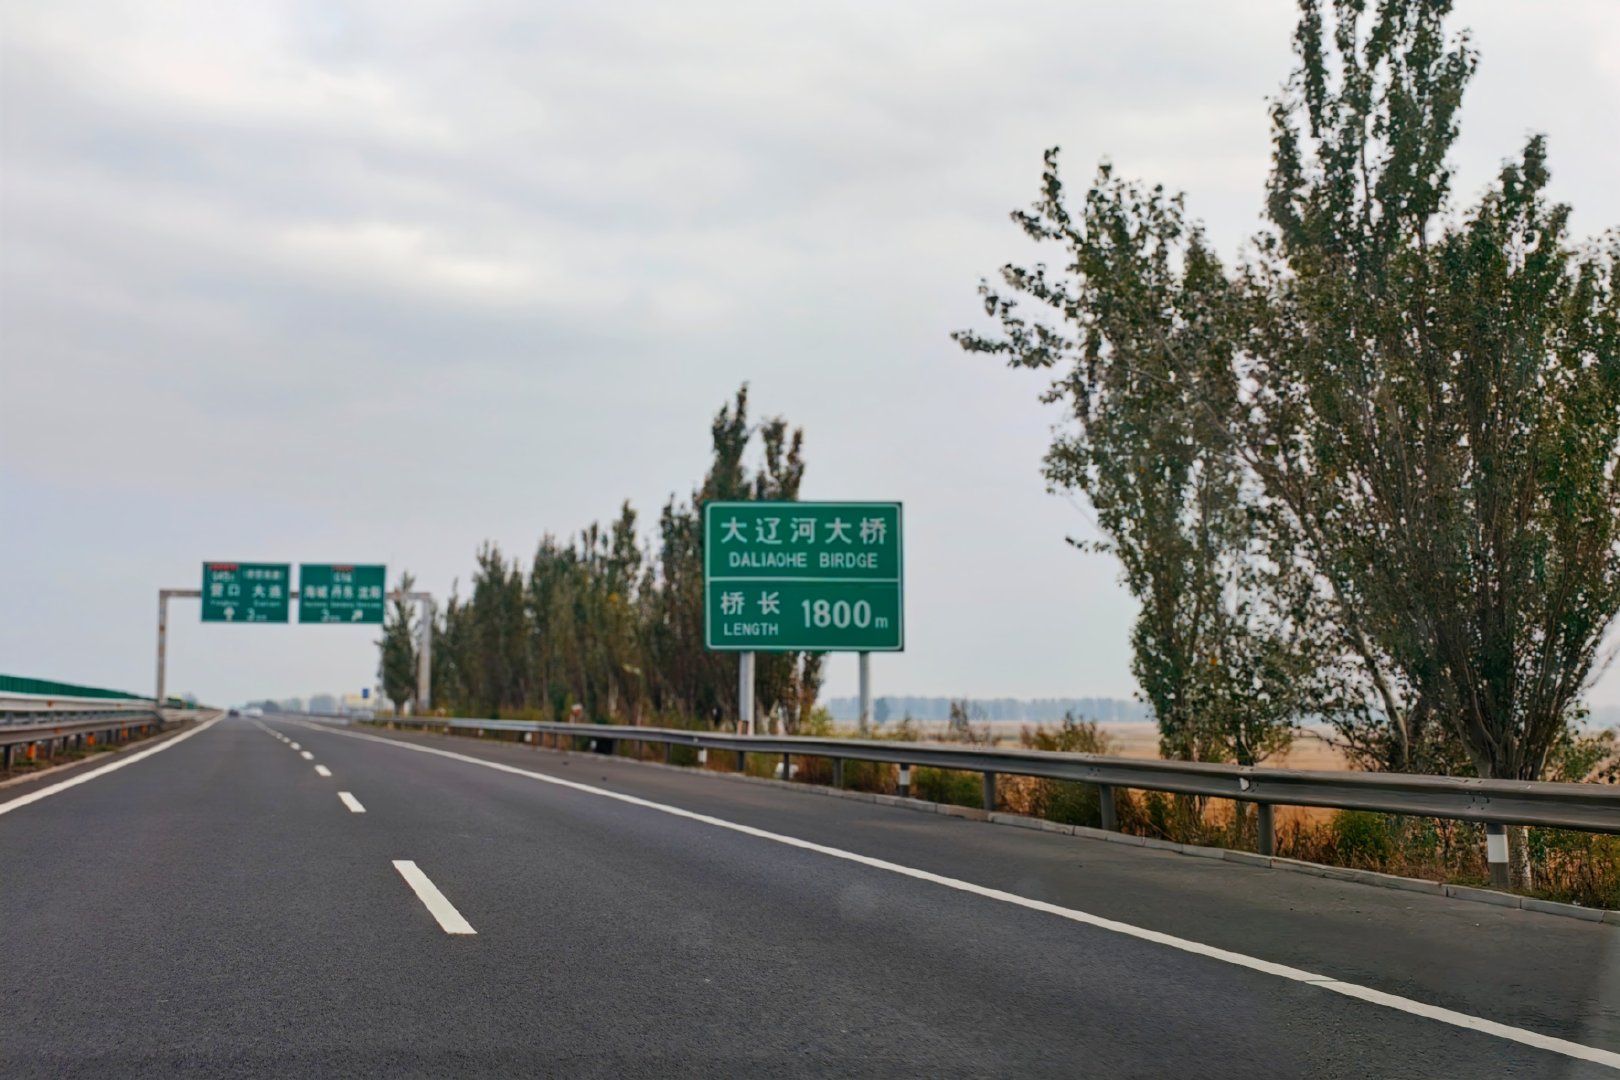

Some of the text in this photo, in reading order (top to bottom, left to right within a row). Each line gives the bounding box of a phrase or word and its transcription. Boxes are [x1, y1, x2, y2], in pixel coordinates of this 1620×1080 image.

[720, 516, 887, 545] 大辽河大桥
[729, 551, 878, 568] DALIAOHE BIRDGE
[720, 591, 780, 615] 桥长
[724, 623, 779, 636] LENGTH
